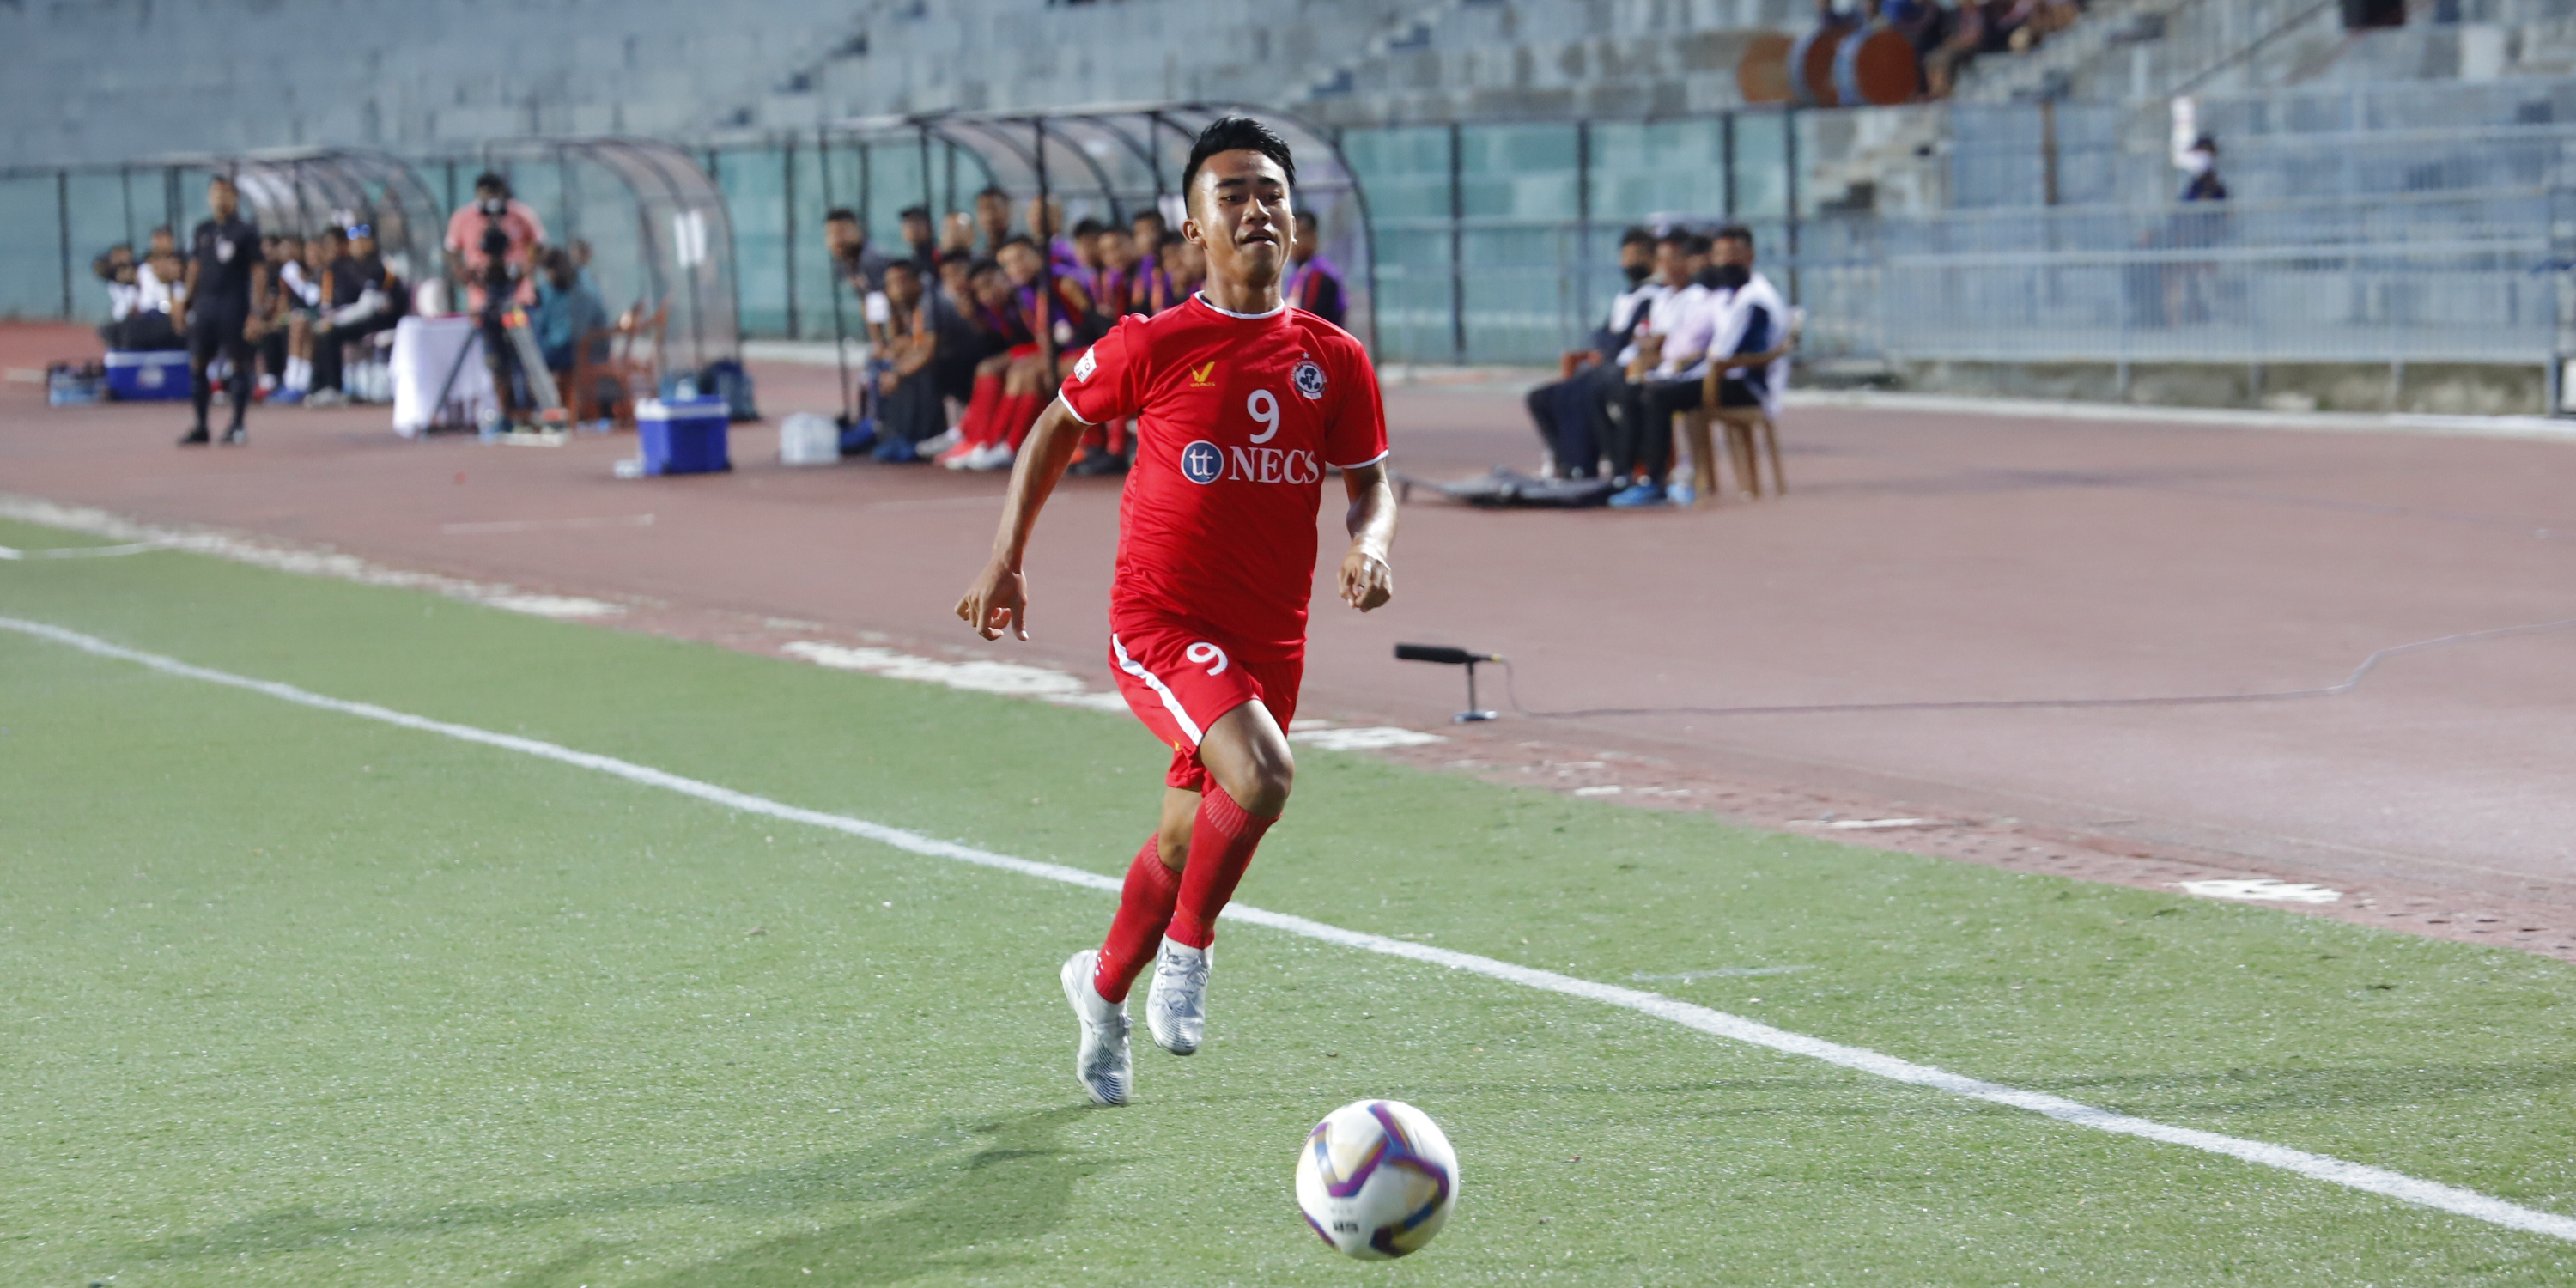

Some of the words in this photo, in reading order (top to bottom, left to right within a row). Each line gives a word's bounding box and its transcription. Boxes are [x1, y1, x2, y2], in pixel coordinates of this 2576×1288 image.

[1247, 388, 1280, 445] 9
[1228, 445, 1320, 485] NECS
[1186, 641, 1228, 677] 9
